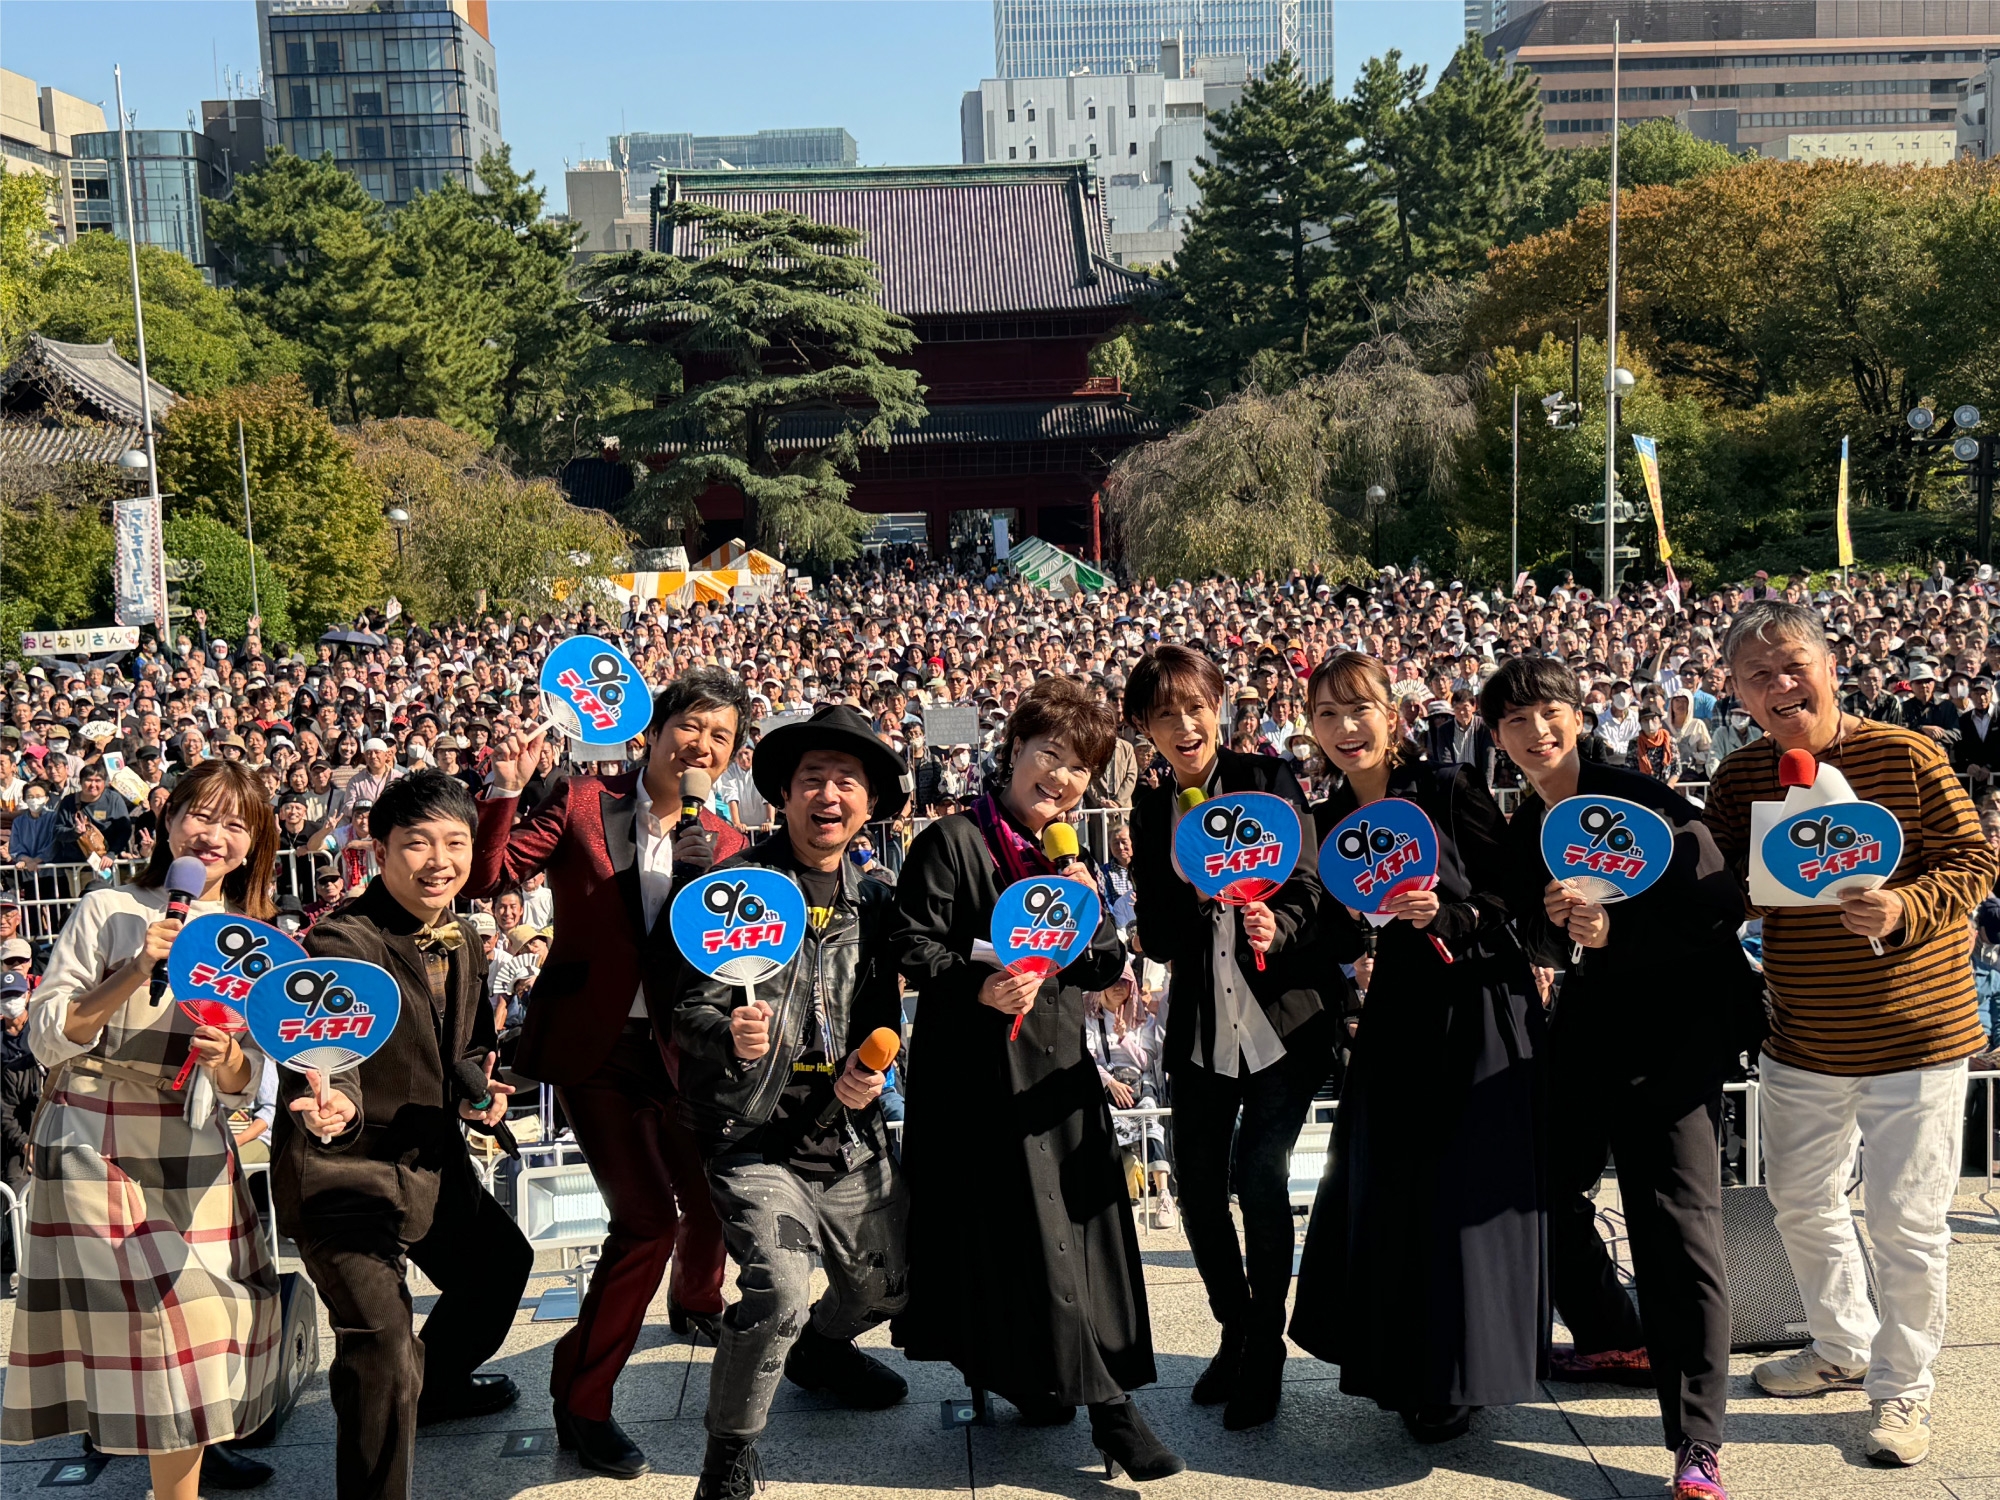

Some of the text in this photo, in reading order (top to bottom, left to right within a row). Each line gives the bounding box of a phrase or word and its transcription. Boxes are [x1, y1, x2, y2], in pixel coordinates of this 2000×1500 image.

[23, 632, 122, 649] おとなりさん
[557, 669, 617, 729] テイチク
[587, 654, 629, 720] 90th
[1203, 805, 1275, 851] 90th
[1337, 820, 1408, 866] 90th
[1580, 805, 1643, 857] 90th
[1789, 815, 1872, 857] 90th
[1205, 843, 1283, 877] テイチク
[1353, 839, 1421, 896] テイチク
[1563, 845, 1646, 879] テイチク
[1799, 841, 1881, 881] テイチク
[703, 881, 779, 927] 90th
[1024, 885, 1075, 928] 90th
[703, 922, 786, 954] テイチク
[1009, 928, 1078, 949] テイチク
[190, 963, 253, 1001] テイチ
[285, 969, 368, 1017] 90th
[278, 1015, 376, 1042] テイチク
[522, 1436, 534, 1449] 1
[61, 1467, 86, 1479] 2
